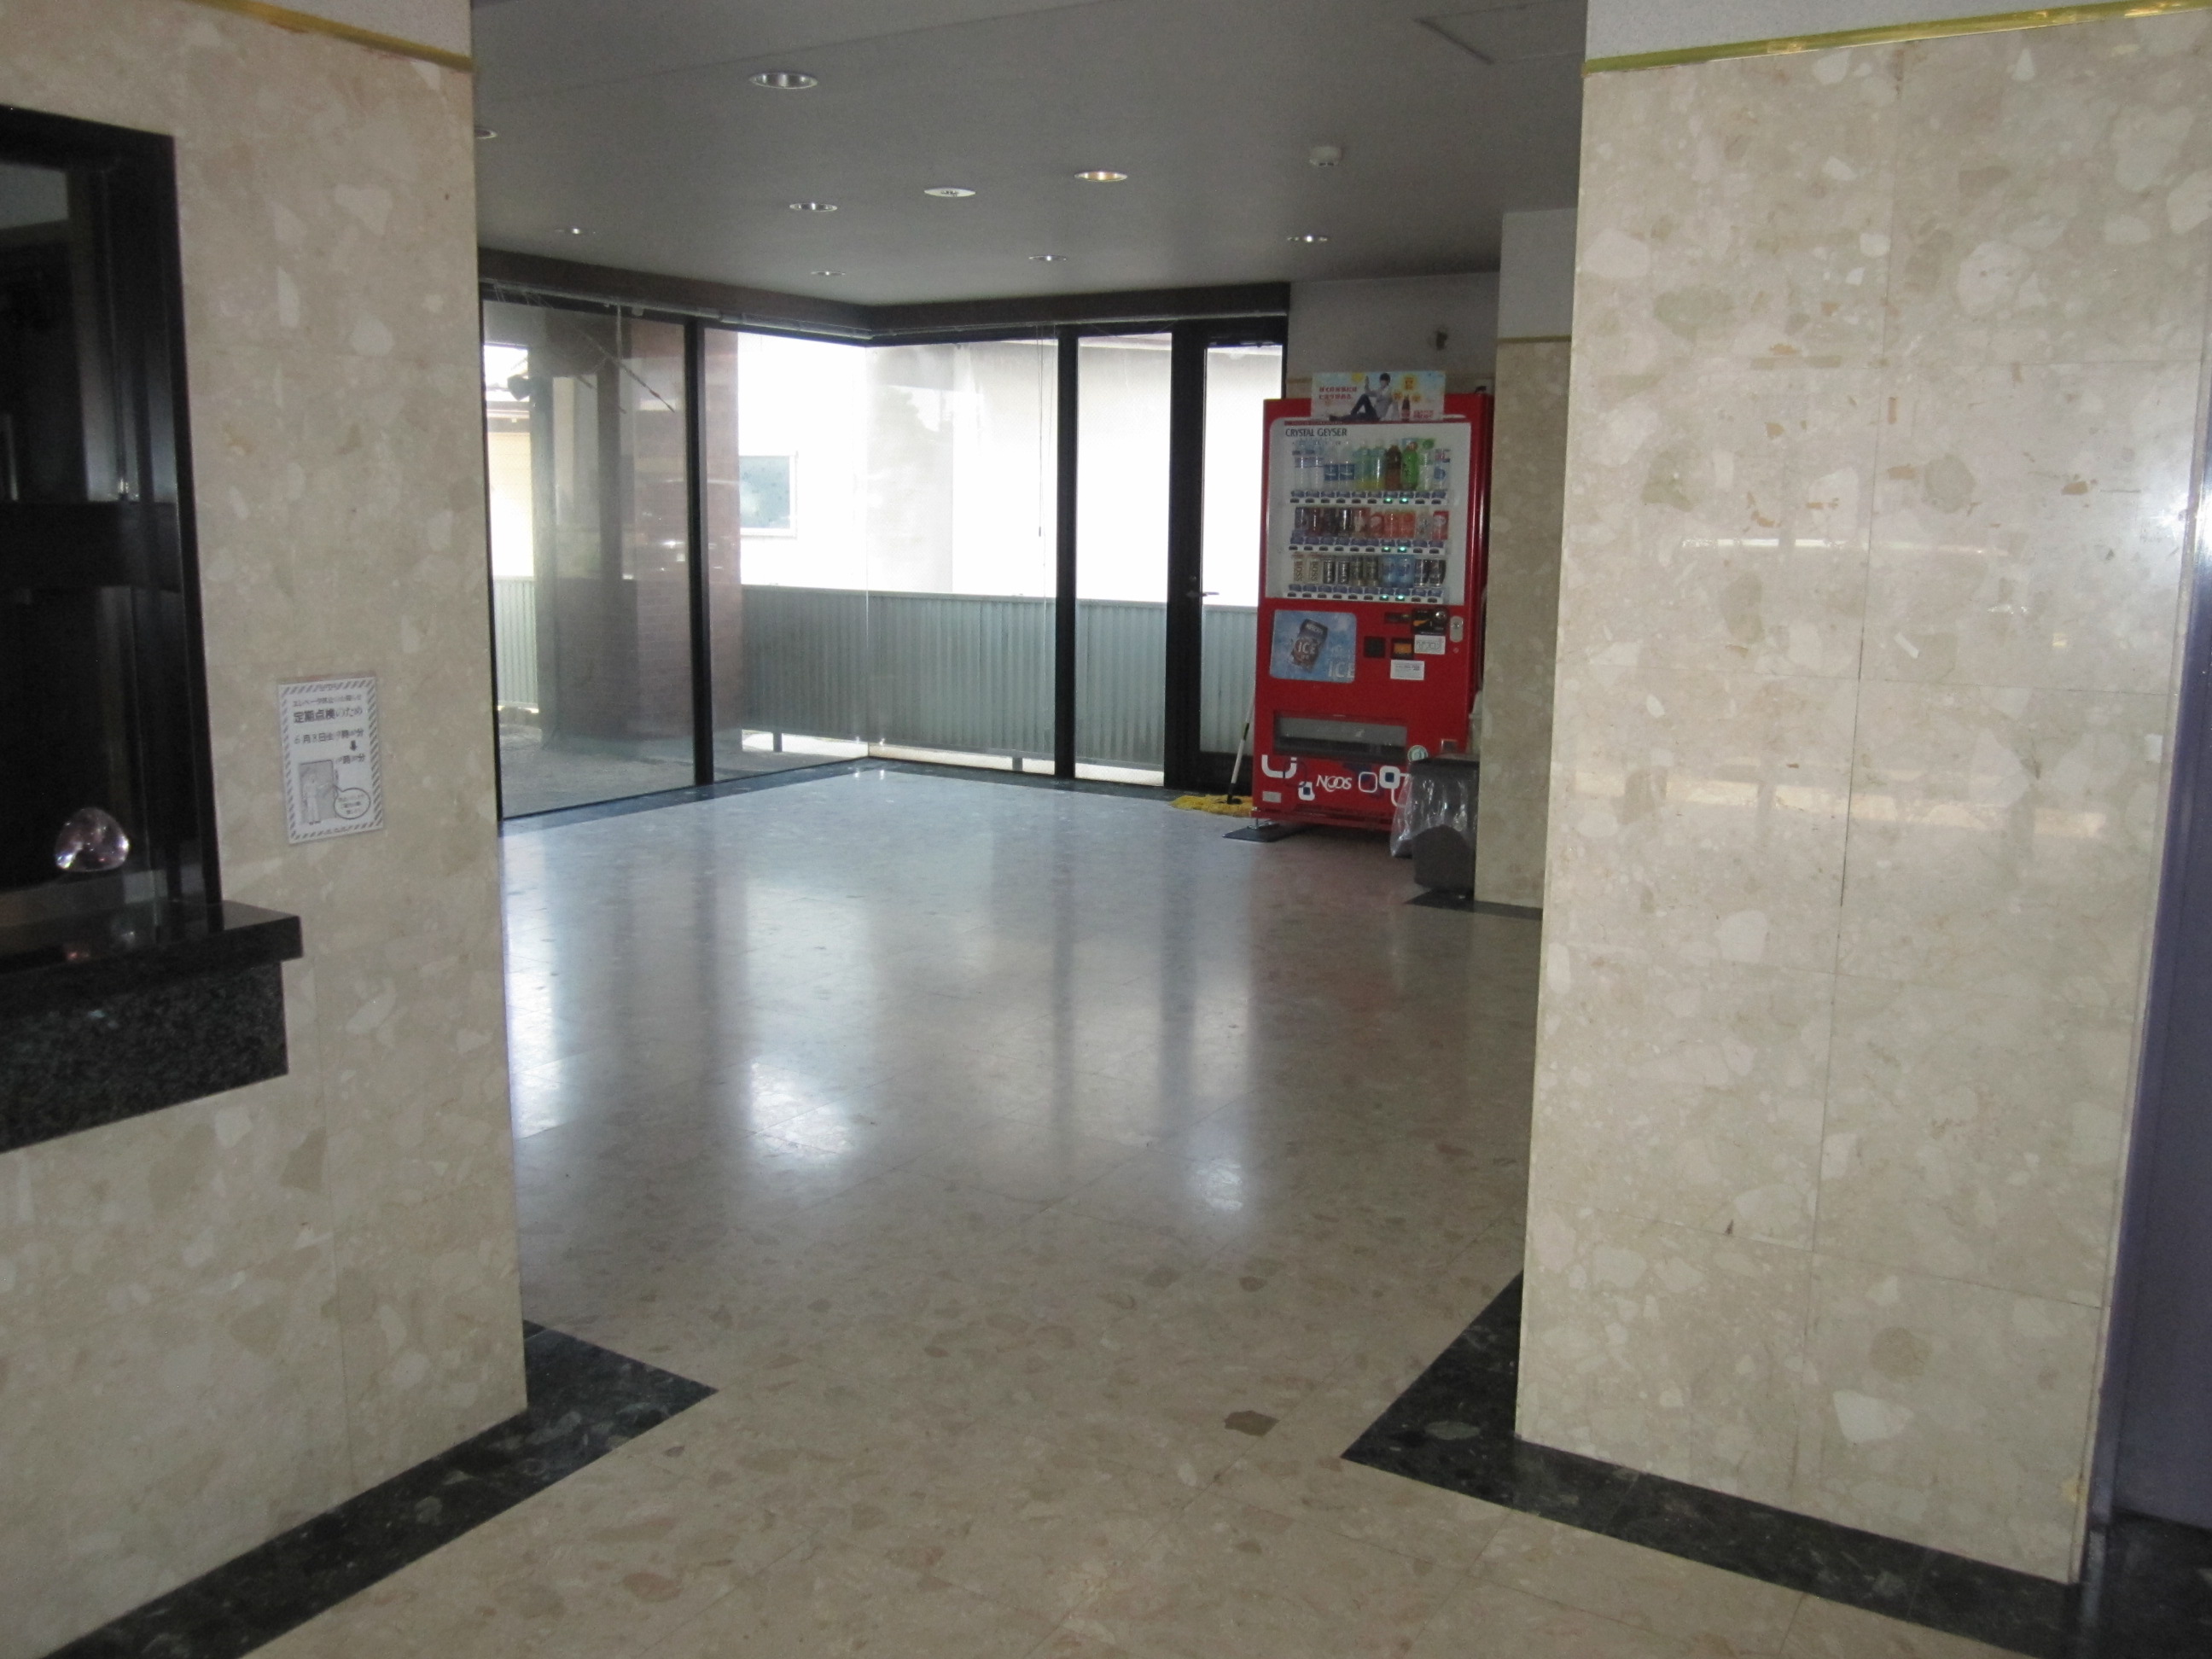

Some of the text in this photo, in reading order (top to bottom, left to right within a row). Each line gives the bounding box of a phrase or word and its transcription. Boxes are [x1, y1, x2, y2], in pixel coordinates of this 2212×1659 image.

[1285, 428, 1348, 437] CRYSTAL GEYSER
[1297, 641, 1315, 655] ICE
[293, 706, 363, 724] 定期点検のため
